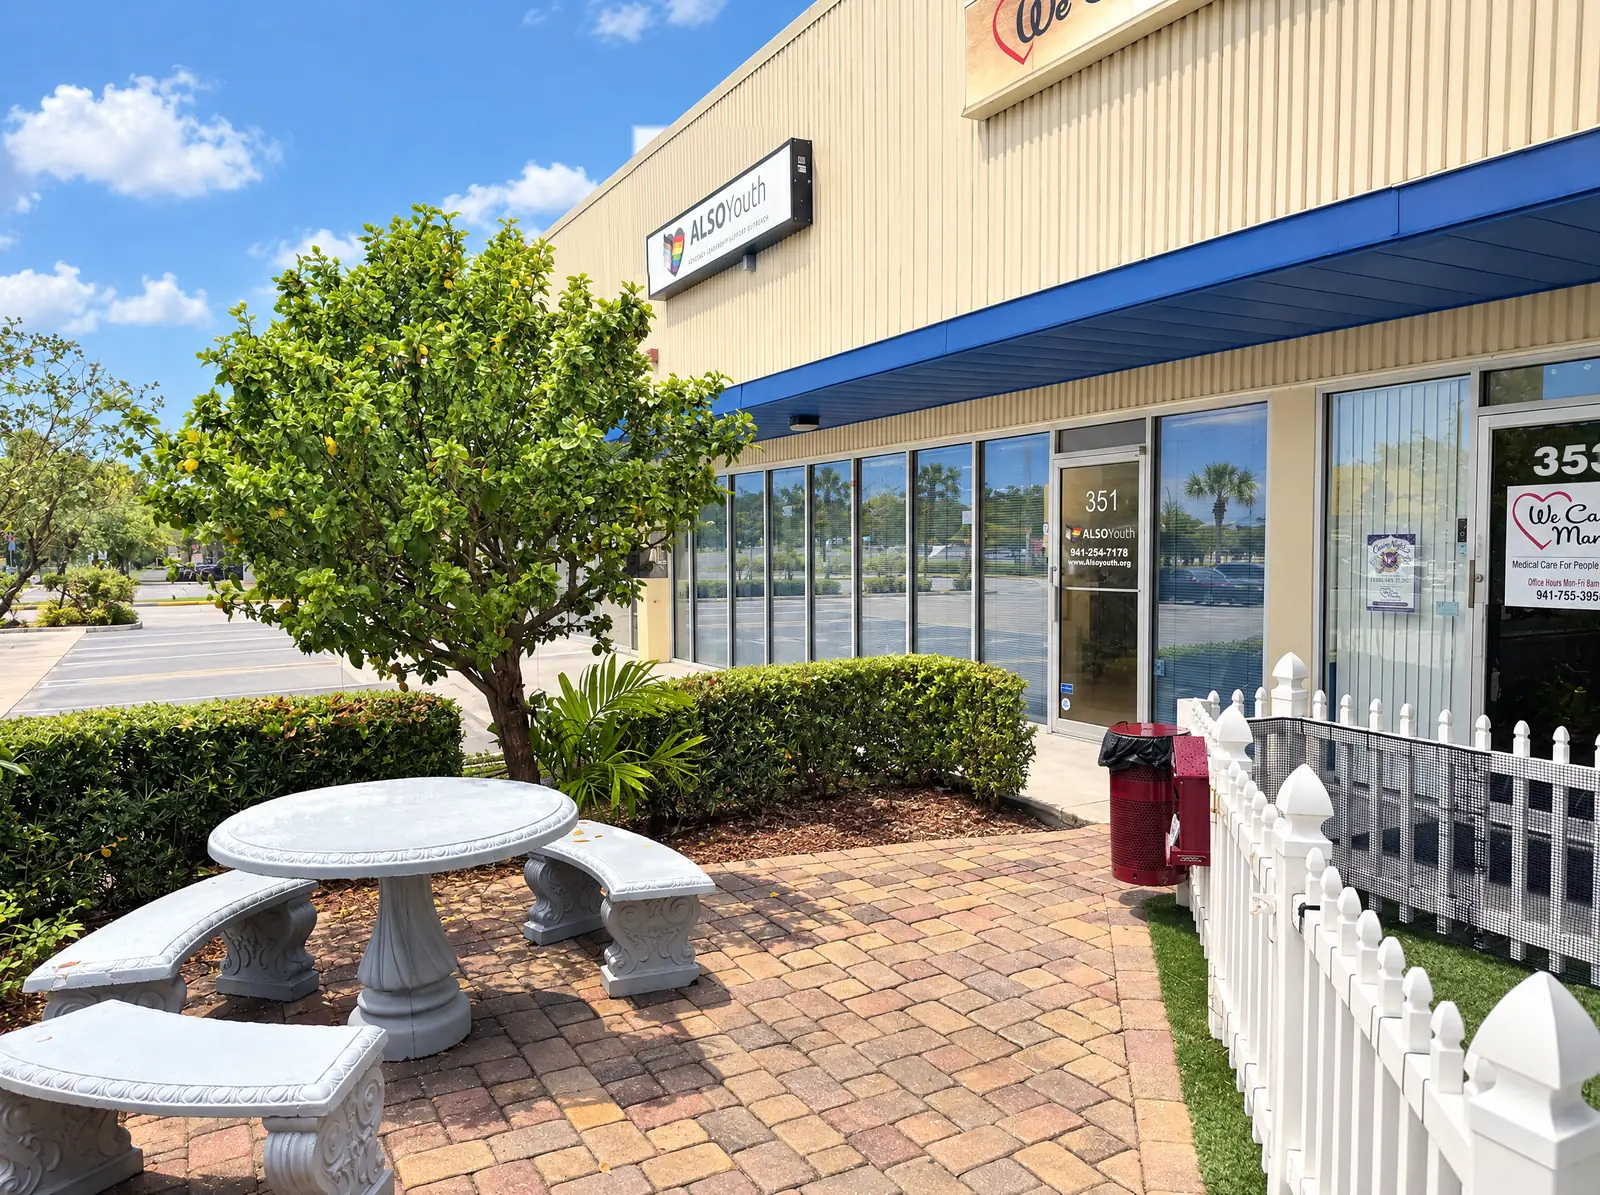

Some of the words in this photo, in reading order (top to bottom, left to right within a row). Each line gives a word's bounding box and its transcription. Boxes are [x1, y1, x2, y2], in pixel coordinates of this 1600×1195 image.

[1016, 0, 1072, 43] We
[690, 174, 766, 246] ALSOYouth
[1085, 489, 1117, 513] 351
[1529, 504, 1561, 525] We
[1082, 527, 1136, 539] ALSOYouth
[1070, 548, 1128, 557] 941-254-7178
[1068, 559, 1131, 568] www.Alsoyouth.org
[1512, 560, 1539, 569] Medical
[1540, 560, 1558, 569] Care
[1560, 561, 1572, 569] For
[1573, 560, 1599, 571] People
[1528, 577, 1544, 587] Office
[1545, 578, 1562, 587] Hours
[1563, 578, 1585, 588] Mon-Fri
[1536, 589, 1600, 602] 941-755-395
